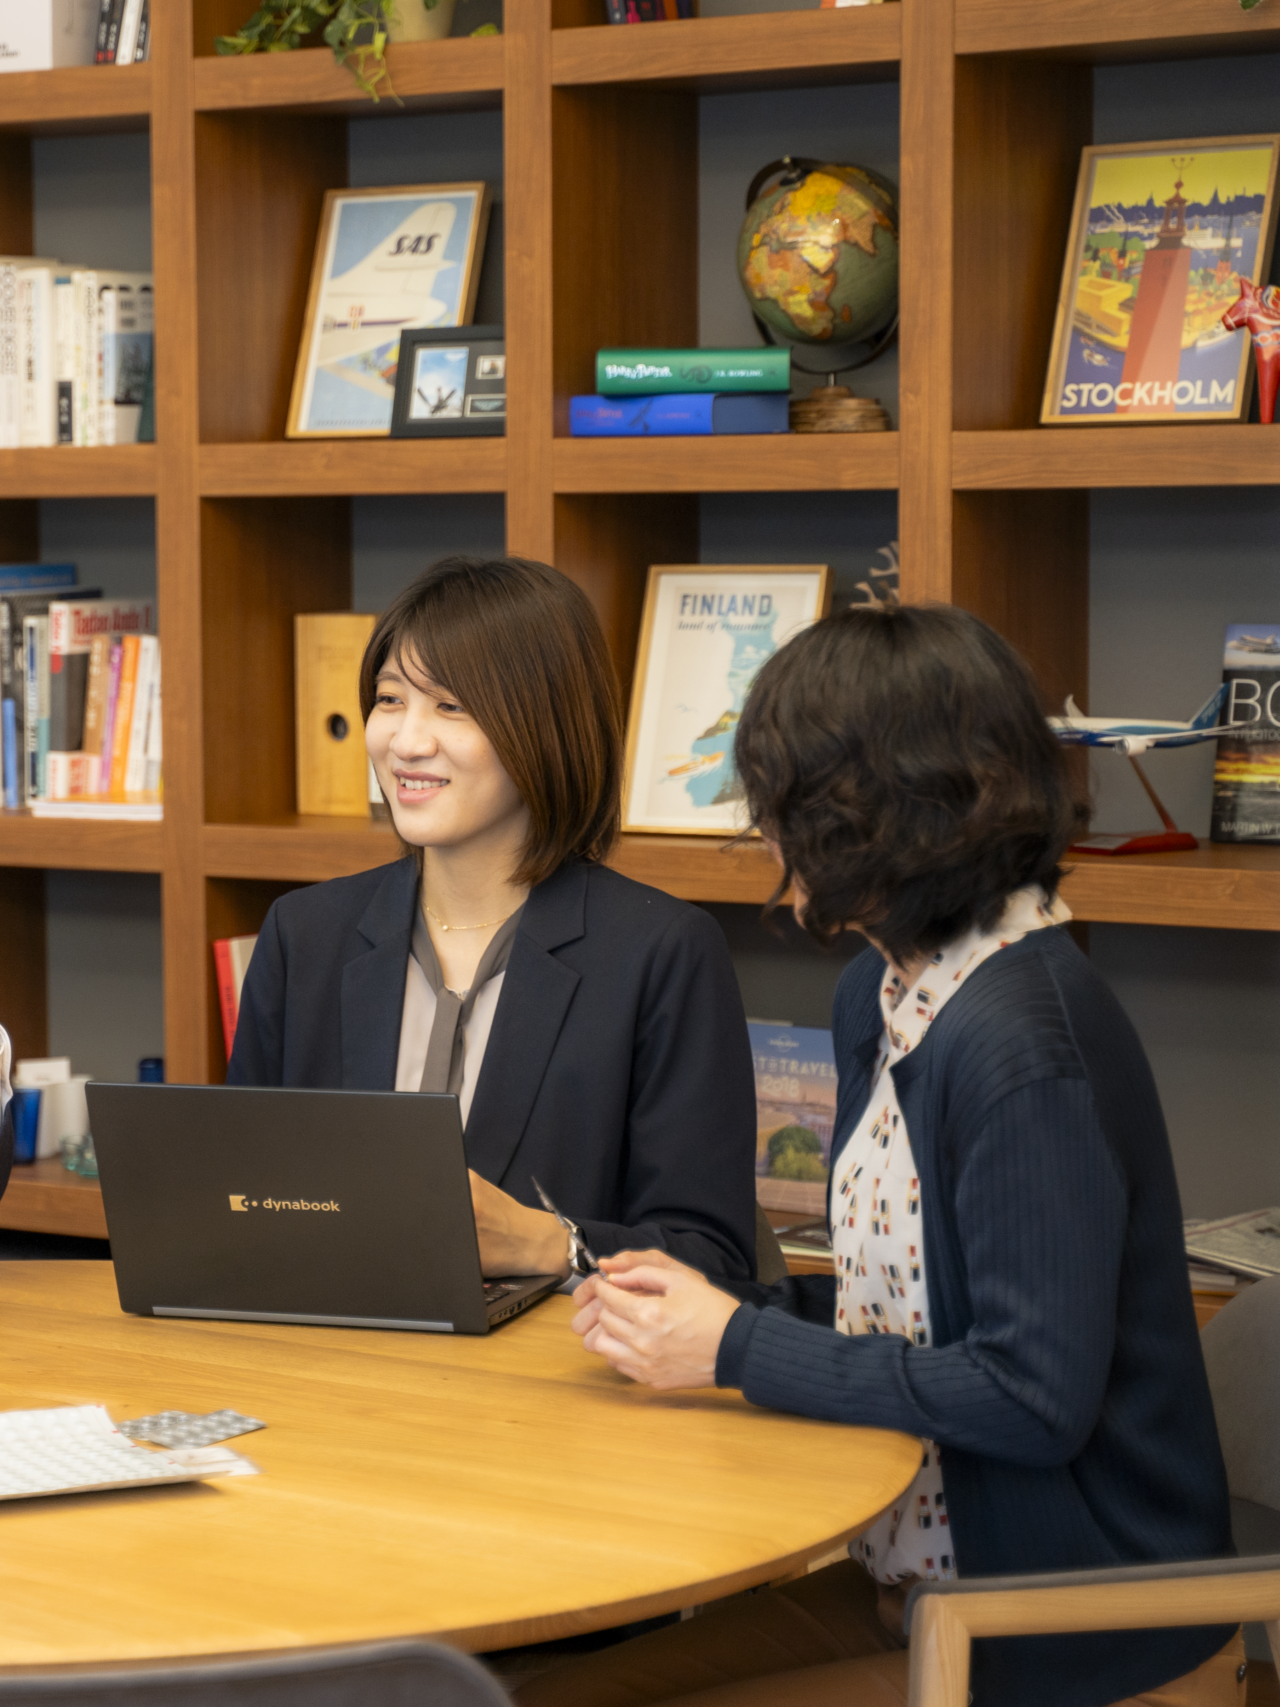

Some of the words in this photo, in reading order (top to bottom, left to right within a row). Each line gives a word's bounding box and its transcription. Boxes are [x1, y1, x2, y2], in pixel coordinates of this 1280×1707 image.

[388, 233, 441, 256] SAS
[1062, 379, 1236, 408] STOCKHOLM
[680, 594, 773, 617] FINLAND
[678, 621, 703, 631] land
[779, 1058, 837, 1079] TRAVEL
[761, 1074, 801, 1098] 2018
[262, 1198, 341, 1212] dynabook
